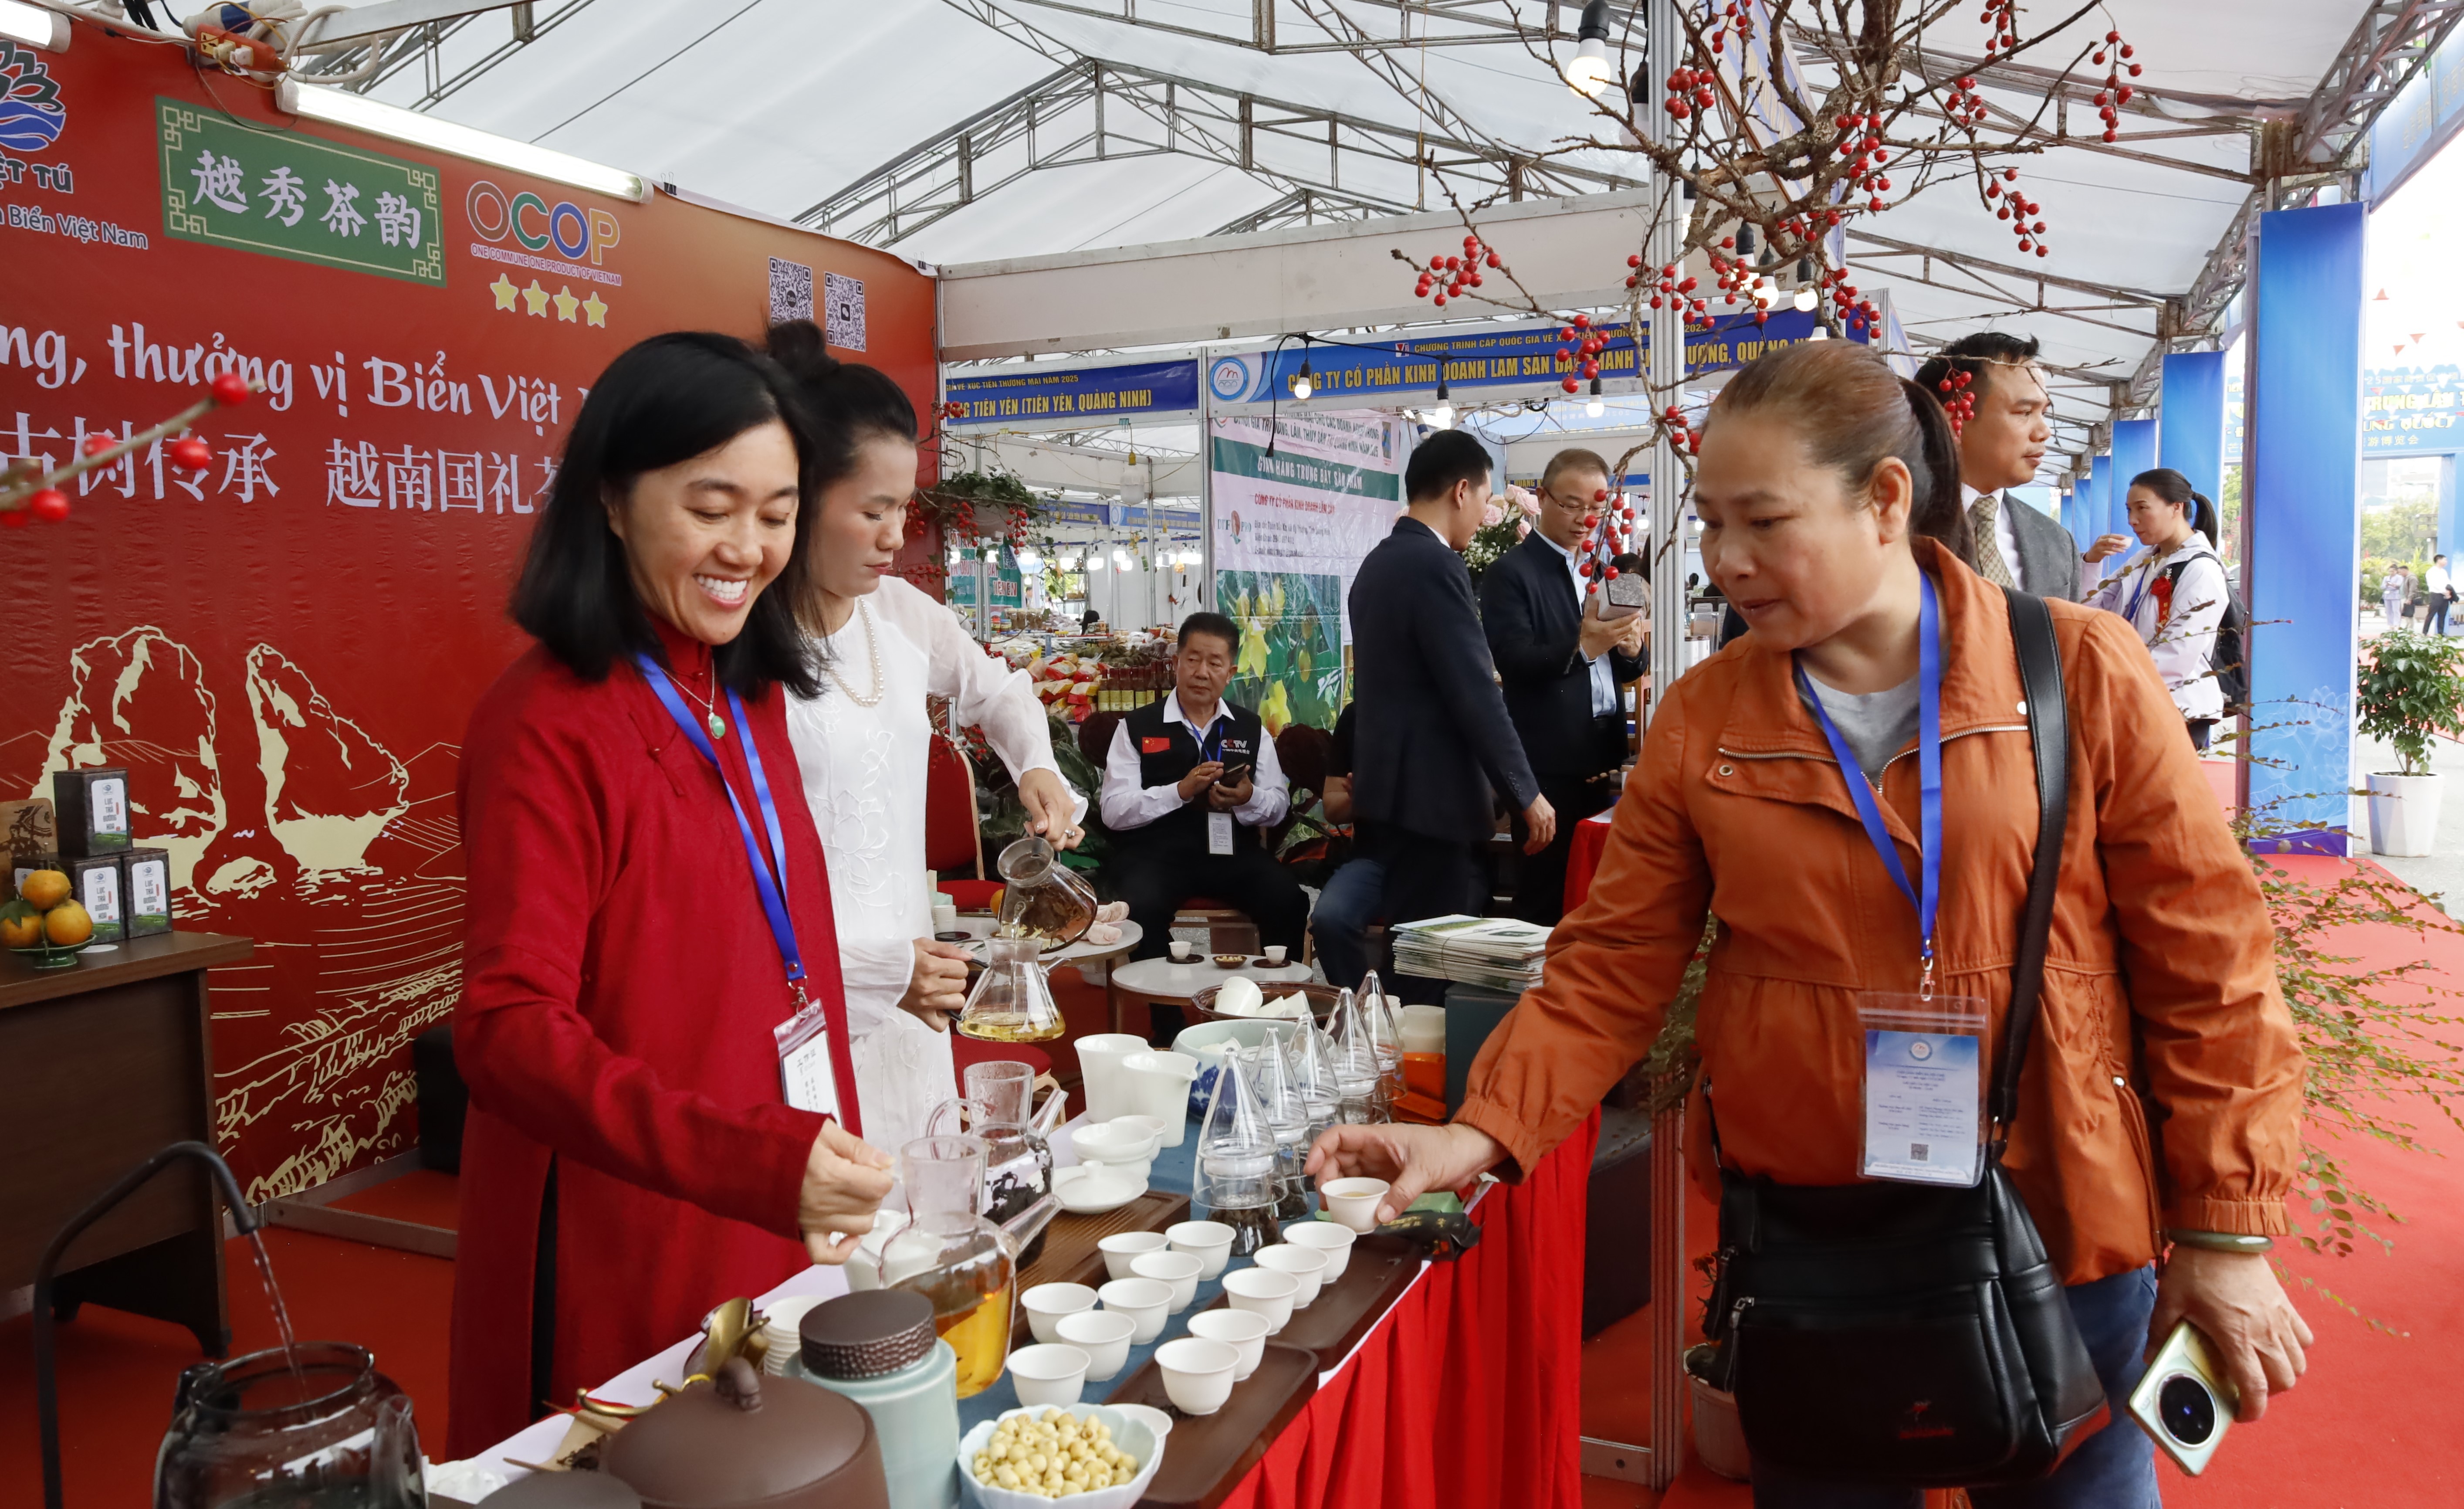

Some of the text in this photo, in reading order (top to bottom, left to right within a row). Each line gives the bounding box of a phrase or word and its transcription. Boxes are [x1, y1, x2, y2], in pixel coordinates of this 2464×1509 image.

[30, 163, 74, 193] TÚ
[191, 149, 421, 249] 越秀茶韵
[8, 204, 55, 234] Biển
[57, 213, 99, 243] Việt
[102, 222, 148, 249] Nam
[466, 180, 620, 265] OCOP
[471, 244, 621, 285] ONE COMMUNE ONE PRODUCT OF VIETNAM
[1526, 336, 1540, 344] GIA
[0, 325, 87, 389] ng,
[310, 351, 348, 417] vị
[363, 350, 472, 415] Biển
[478, 374, 561, 436] Việt
[1326, 370, 1340, 389] TY
[1345, 363, 1362, 388] CỔ
[1367, 361, 1400, 386] PHẦN
[1405, 363, 1437, 383] KINH
[1442, 359, 1486, 381] DOANH
[1523, 352, 1550, 376] SẢN
[974, 398, 996, 417] TIÊN
[999, 396, 1019, 415] YÊN
[1053, 392, 1075, 412] YÊN,
[1079, 389, 1116, 412] QUẢNG
[1120, 390, 1152, 408] NINH)
[1276, 457, 1295, 478] HÀNG
[1221, 739, 1247, 748] CCTV
